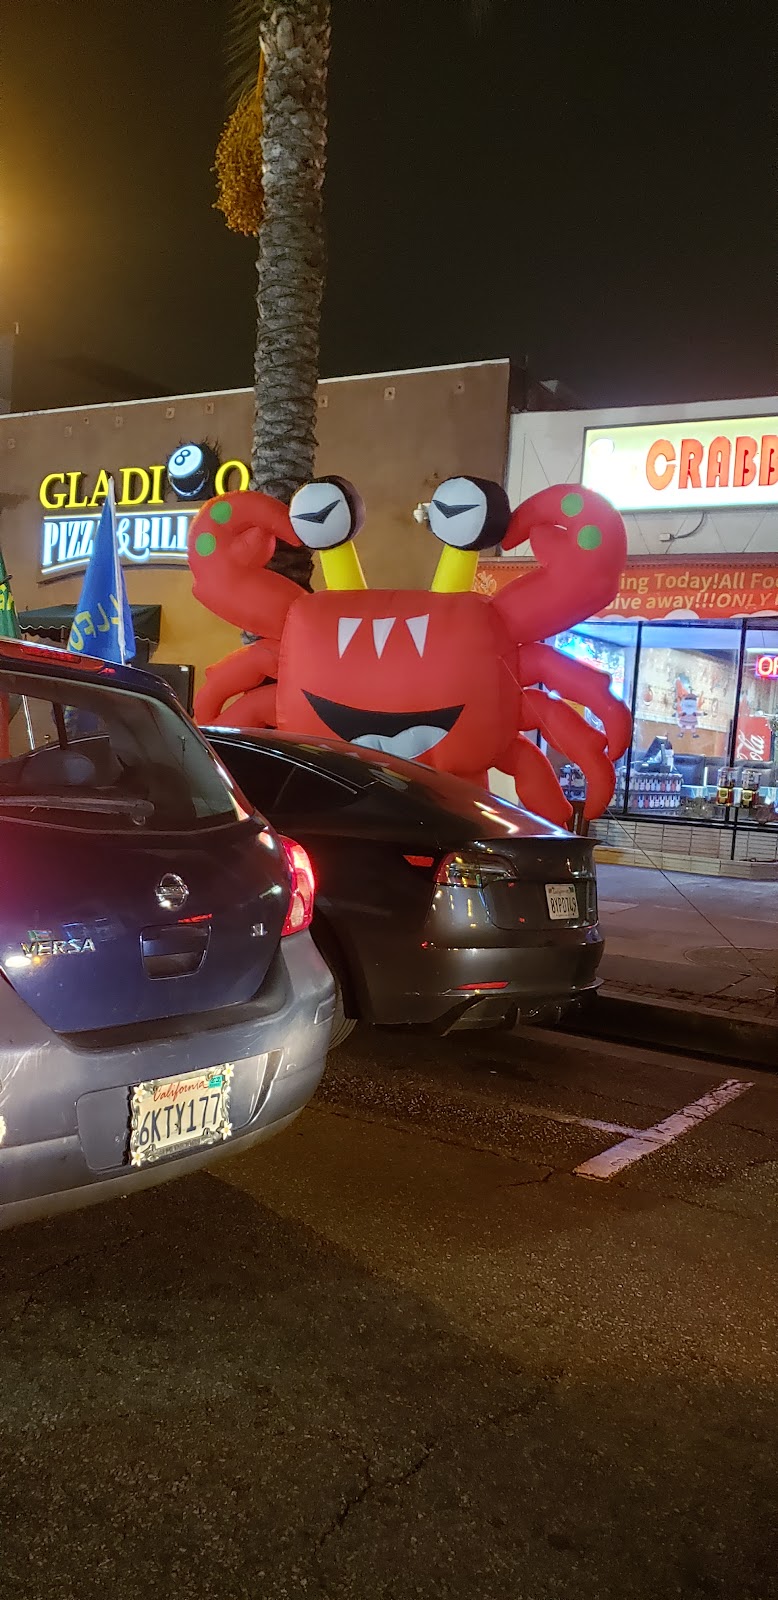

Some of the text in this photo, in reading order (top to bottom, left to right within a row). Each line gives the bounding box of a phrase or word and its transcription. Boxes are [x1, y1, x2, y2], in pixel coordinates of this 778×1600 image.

[646, 434, 778, 491] CRABB
[42, 518, 101, 567] PIZZ
[117, 517, 152, 563] &
[620, 572, 650, 594] ing
[751, 572, 778, 590] Fo
[20, 937, 97, 958] VERSA
[153, 1080, 208, 1102] California
[139, 1093, 221, 1146] 6KTY177
